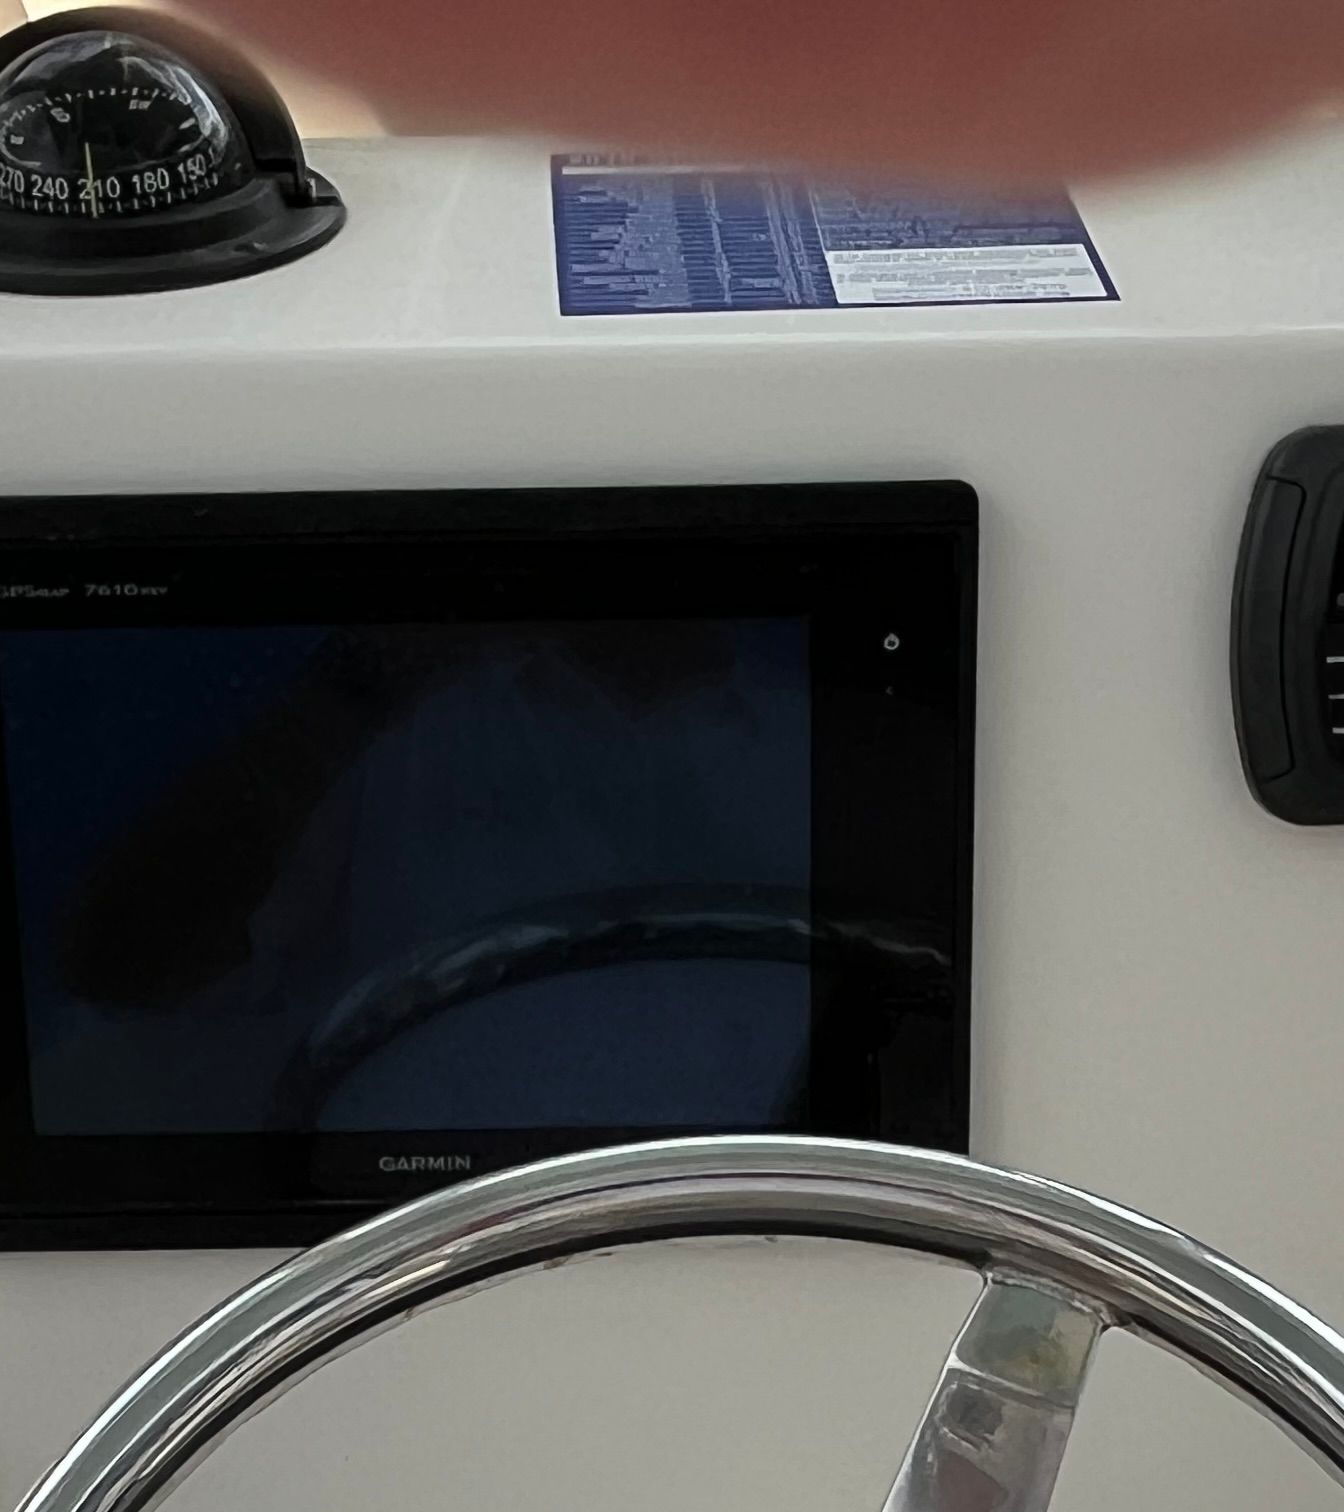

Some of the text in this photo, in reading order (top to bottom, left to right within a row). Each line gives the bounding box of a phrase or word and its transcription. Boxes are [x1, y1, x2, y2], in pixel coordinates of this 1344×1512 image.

[31, 174, 69, 199] 240
[77, 175, 121, 200] 210
[132, 167, 170, 194] 180
[378, 1155, 472, 1172] GARMIN
